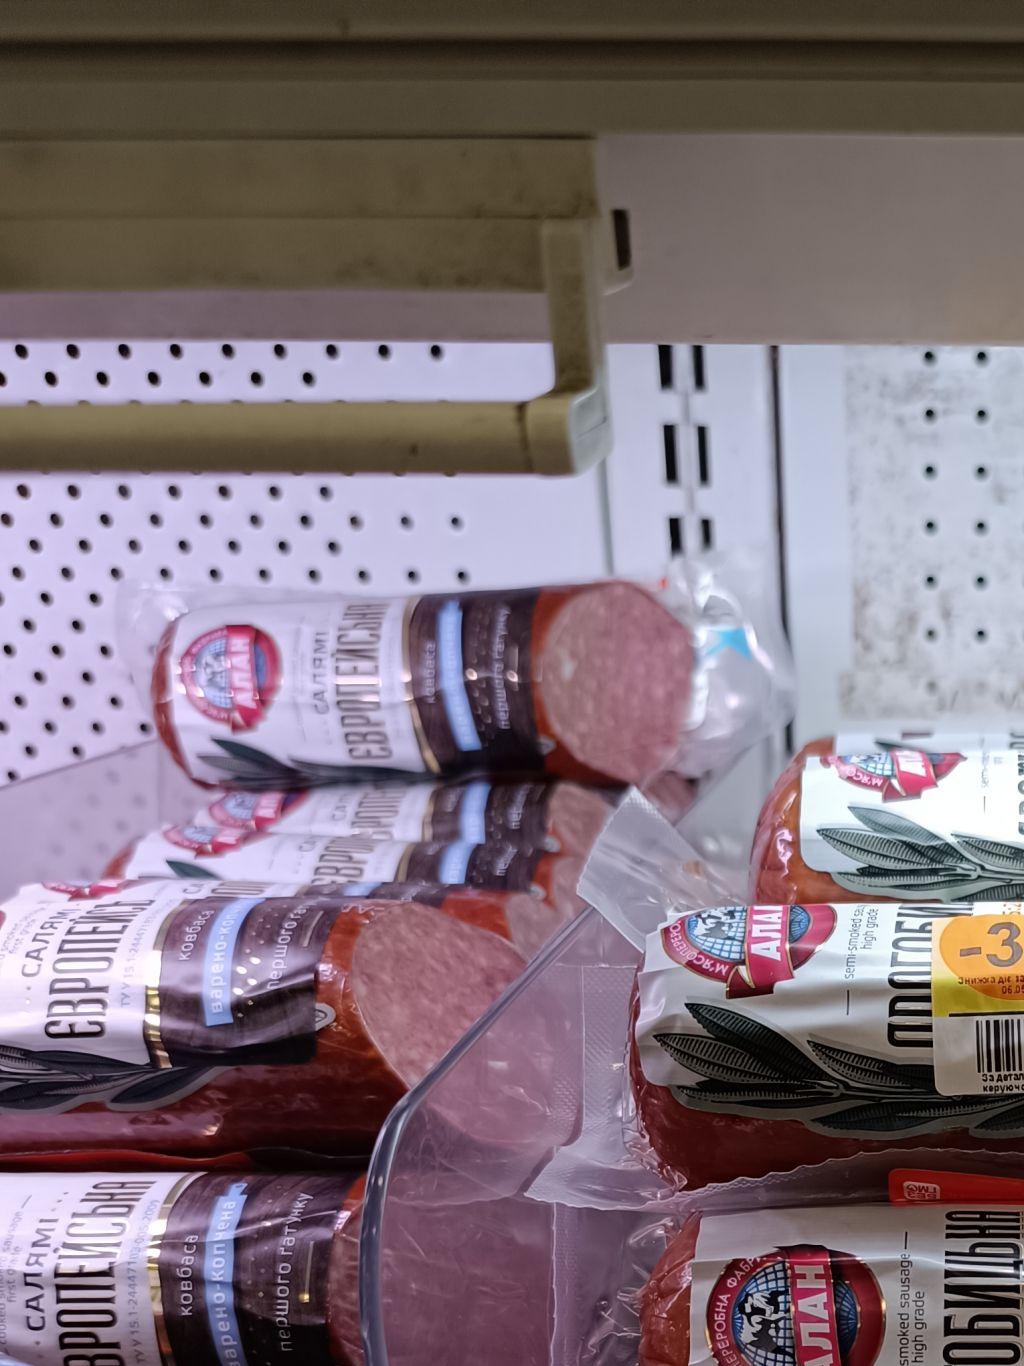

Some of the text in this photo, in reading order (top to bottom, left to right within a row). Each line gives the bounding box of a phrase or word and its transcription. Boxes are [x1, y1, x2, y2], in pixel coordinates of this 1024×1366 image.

[21, 906, 77, 979] САЛЯМІ
[45, 899, 154, 1040] ЄВРОПЕЙСЬ
[178, 909, 215, 961] ковбаса
[208, 900, 247, 1014] варено-коп
[267, 922, 300, 990] першого
[24, 1218, 57, 1332] САЛЯМІ
[177, 1235, 199, 1316] ковбаса
[273, 1191, 314, 1352] першого ґатунку
[899, 1253, 914, 1309] sausage
[912, 1291, 928, 1364] high grade
